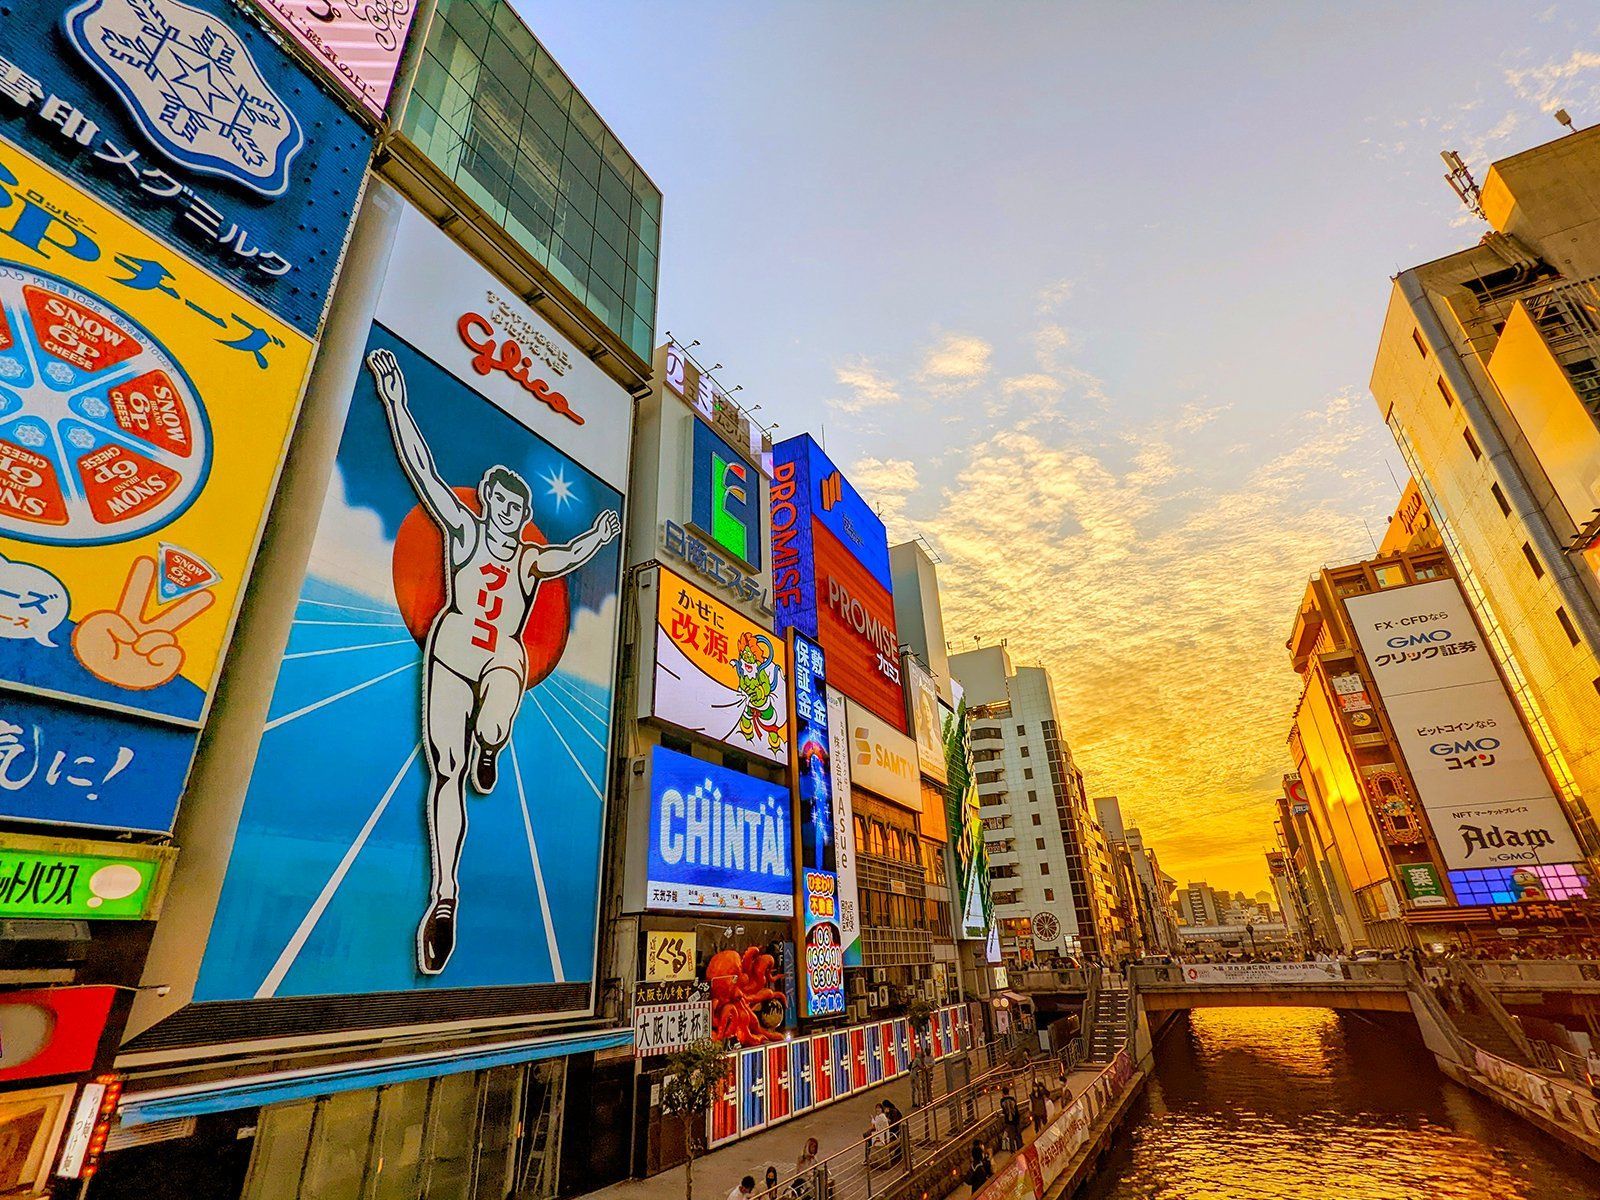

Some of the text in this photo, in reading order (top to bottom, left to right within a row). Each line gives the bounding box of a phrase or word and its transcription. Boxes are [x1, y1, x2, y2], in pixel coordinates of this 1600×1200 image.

[44, 298, 127, 348] SNOW
[63, 320, 99, 344] BRAND
[44, 340, 93, 370] CHEESE
[48, 324, 101, 360] 6P
[457, 311, 586, 426] Glico
[111, 390, 133, 430] CHEESE
[149, 399, 163, 428] BRAND
[152, 384, 186, 446] SNOW
[81, 446, 121, 471] CHEESE
[105, 473, 167, 517] SNOW
[112, 475, 141, 494] BRAND
[166, 573, 187, 588] CHEESE
[172, 554, 205, 577] SNOW
[471, 562, 511, 653] グリコ
[678, 589, 725, 630] かぜに
[828, 573, 899, 663] PROMISE
[671, 607, 729, 665] 改源
[1374, 640, 1478, 667] クリック証券
[1386, 629, 1452, 649] GMO
[796, 639, 811, 719] 保証金
[1416, 718, 1497, 737] ビットコインなら
[875, 743, 914, 782] SAMTY
[1429, 737, 1500, 756] GMO
[1444, 753, 1496, 771] コイン
[660, 778, 785, 877] CHINTAI
[1452, 806, 1528, 819] NFT マーケットプレイス
[1458, 824, 1555, 859] Adam
[1497, 851, 1536, 862] GMO
[656, 937, 687, 973] くくる
[812, 969, 840, 988] 6304
[638, 1010, 700, 1048] 大阪に乾杯
